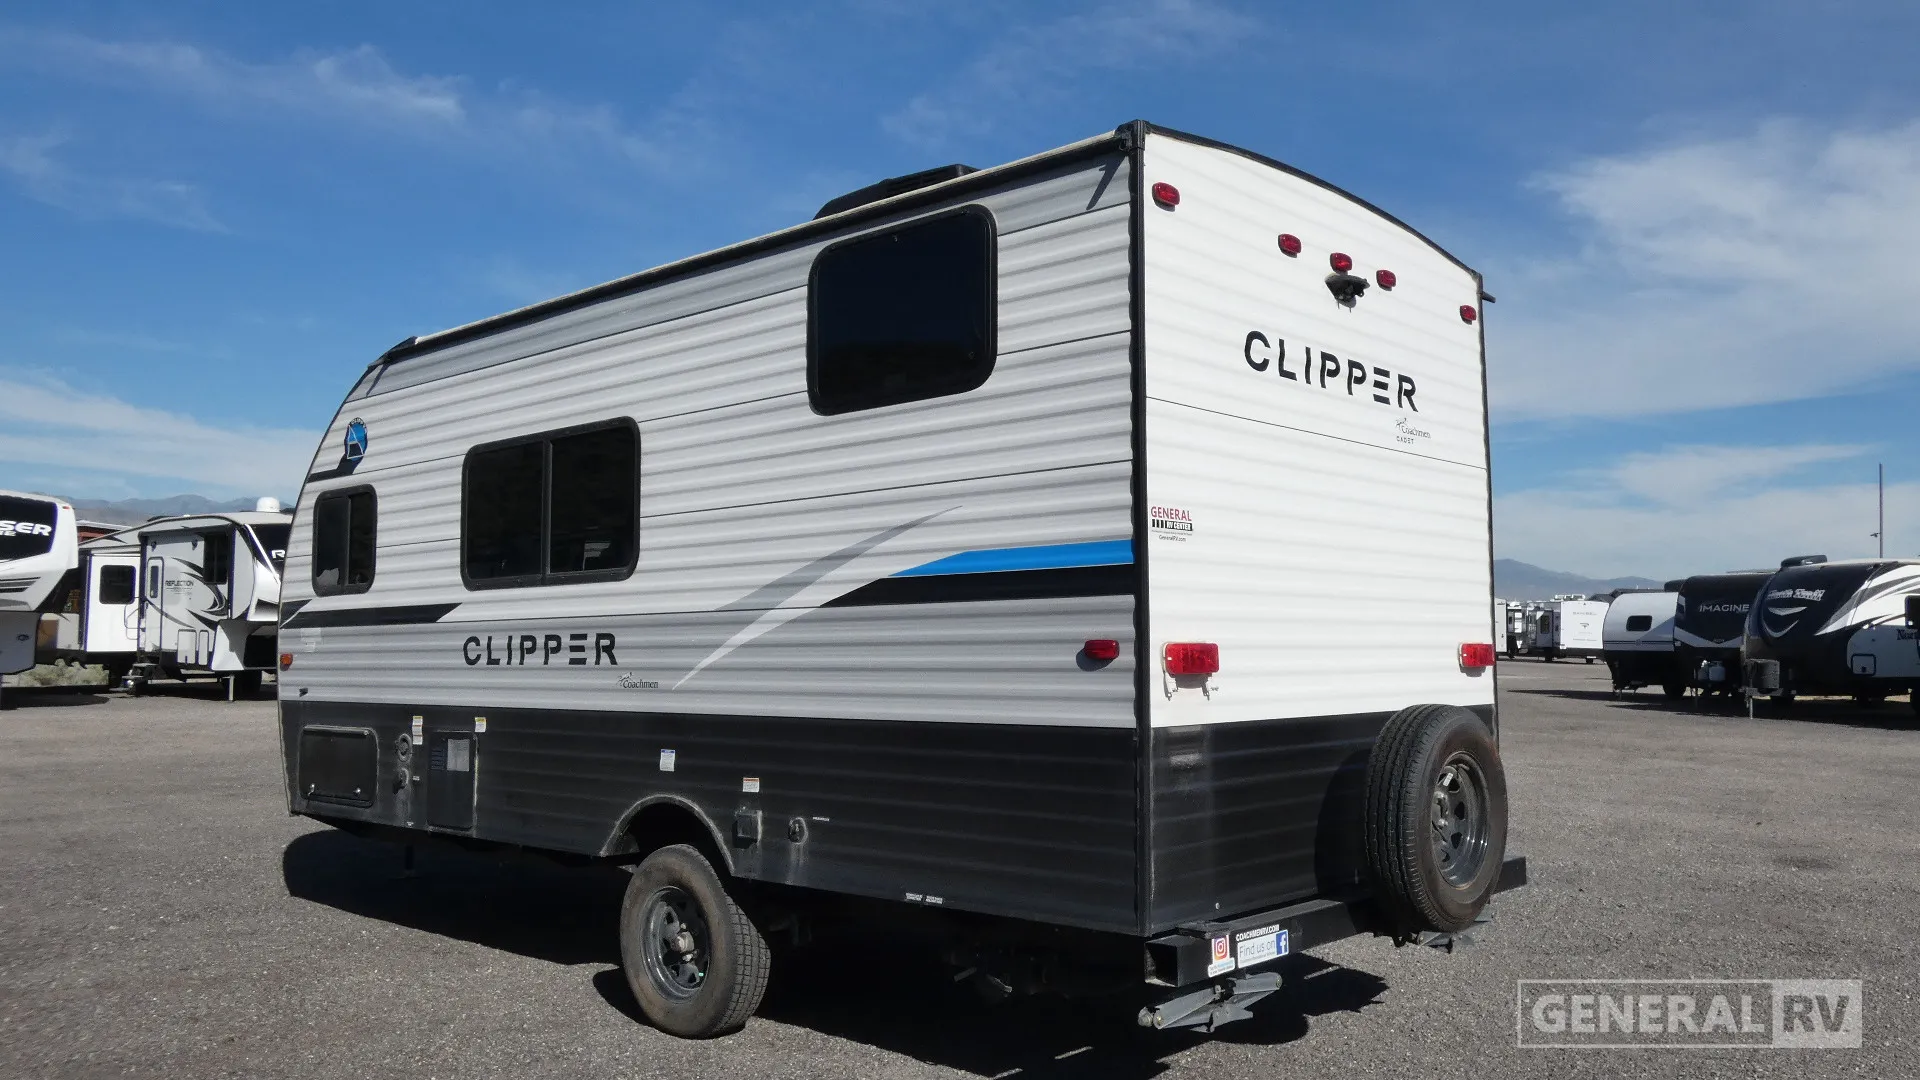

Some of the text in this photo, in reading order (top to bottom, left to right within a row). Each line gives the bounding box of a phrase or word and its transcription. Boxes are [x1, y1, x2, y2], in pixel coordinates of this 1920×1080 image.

[1244, 330, 1419, 413] CLIPPER
[1151, 506, 1192, 521] GENERAL
[1699, 603, 1750, 612] IMAGINE
[462, 632, 618, 666] CLIPPER
[623, 679, 659, 689] Coachmen
[1239, 942, 1255, 958] Find
[1257, 943, 1265, 954] us
[1267, 940, 1276, 951] on
